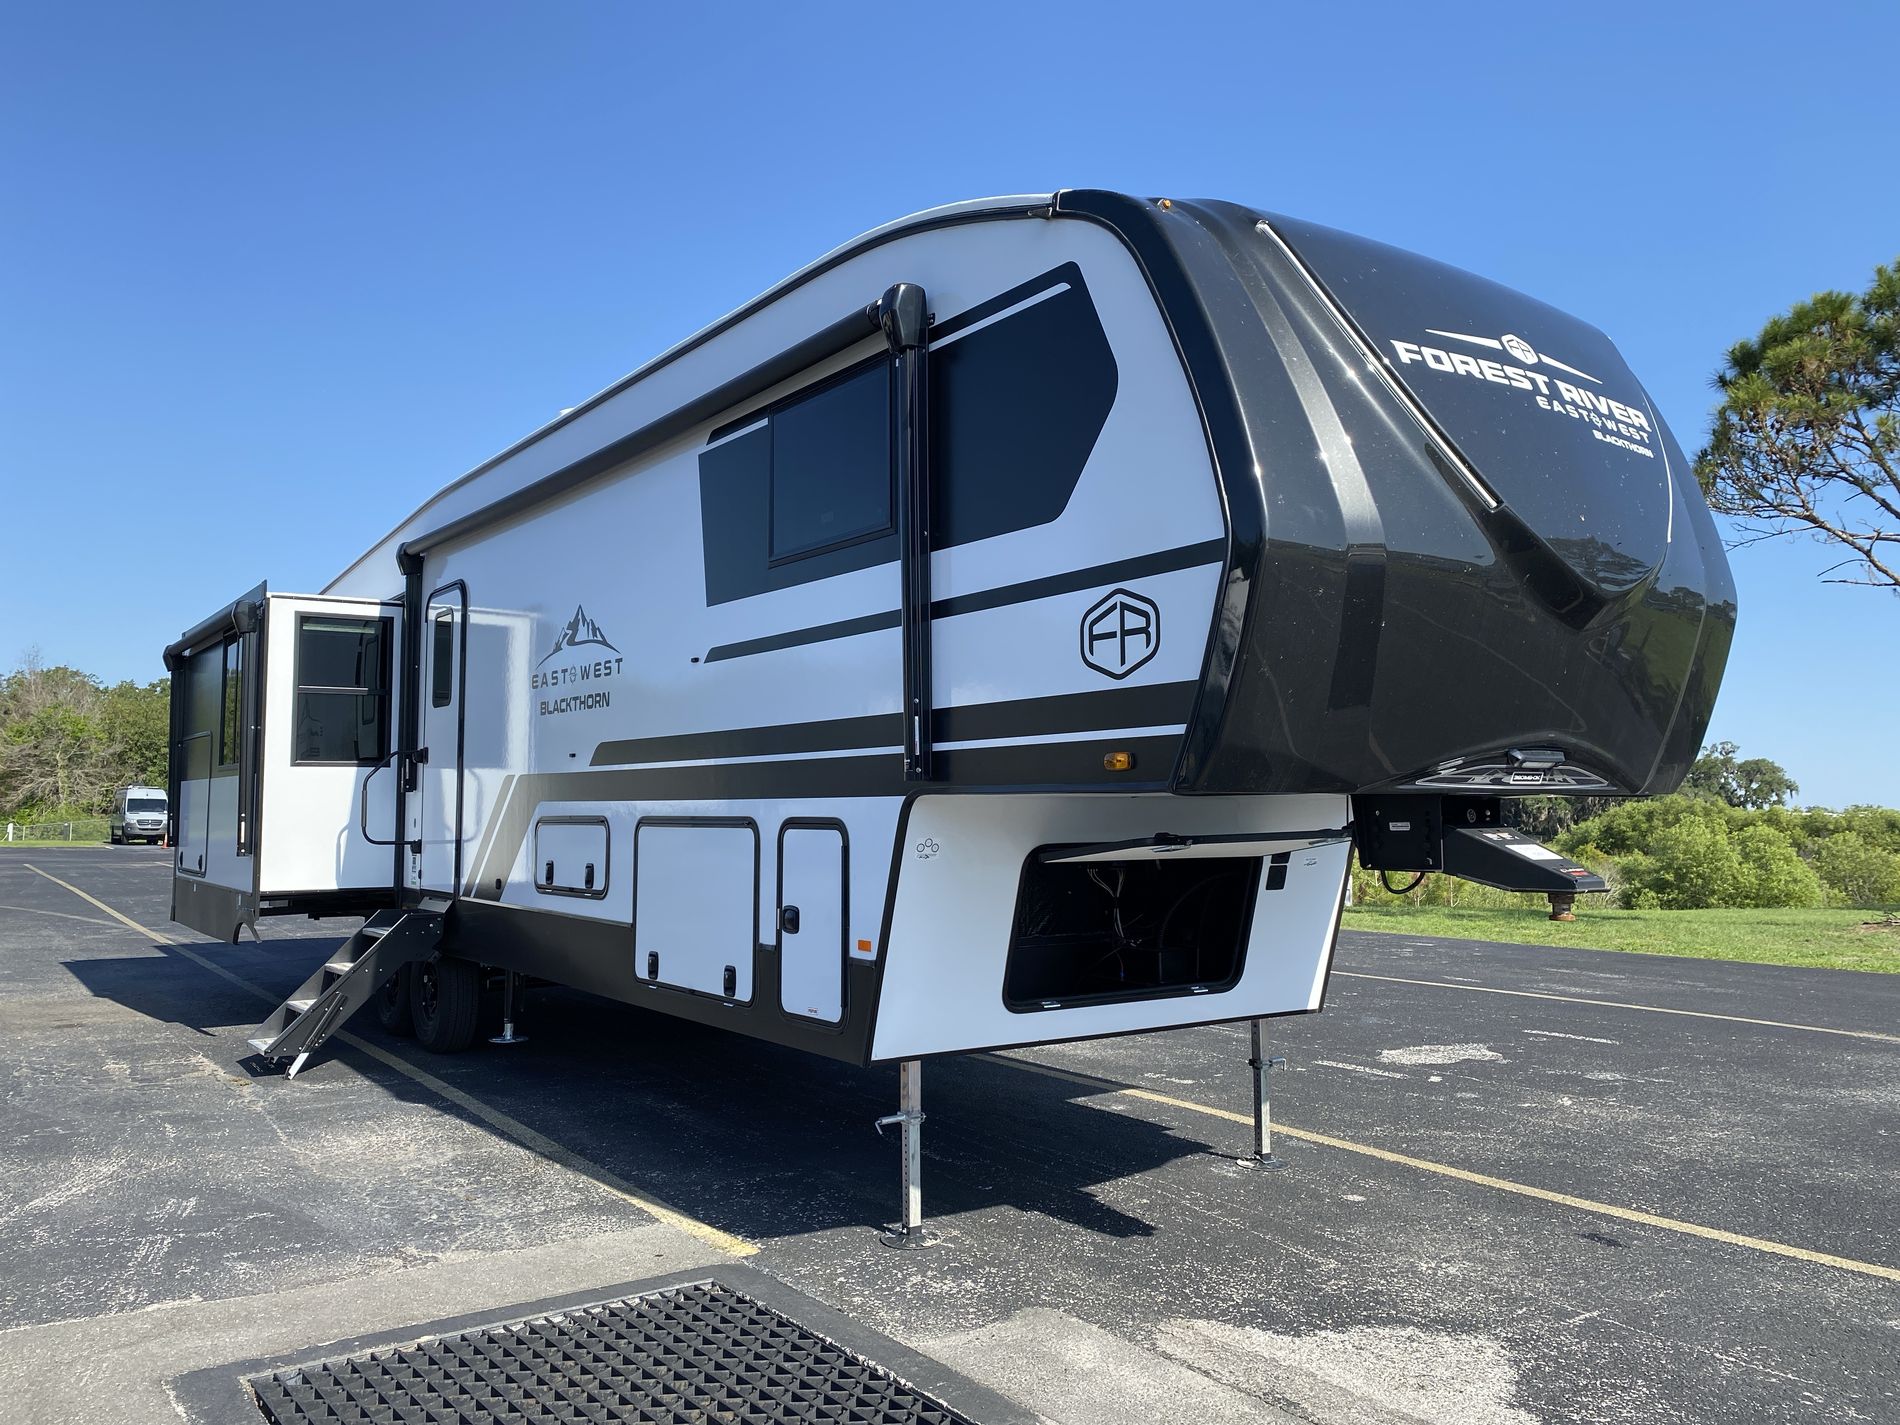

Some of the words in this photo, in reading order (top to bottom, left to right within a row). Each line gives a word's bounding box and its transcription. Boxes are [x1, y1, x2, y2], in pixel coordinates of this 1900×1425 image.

[1389, 339, 1550, 395] FOREST
[1554, 378, 1653, 433] RIVER
[1592, 429, 1655, 459] BLACKTHORN
[539, 691, 611, 716] BLACKTHORN
